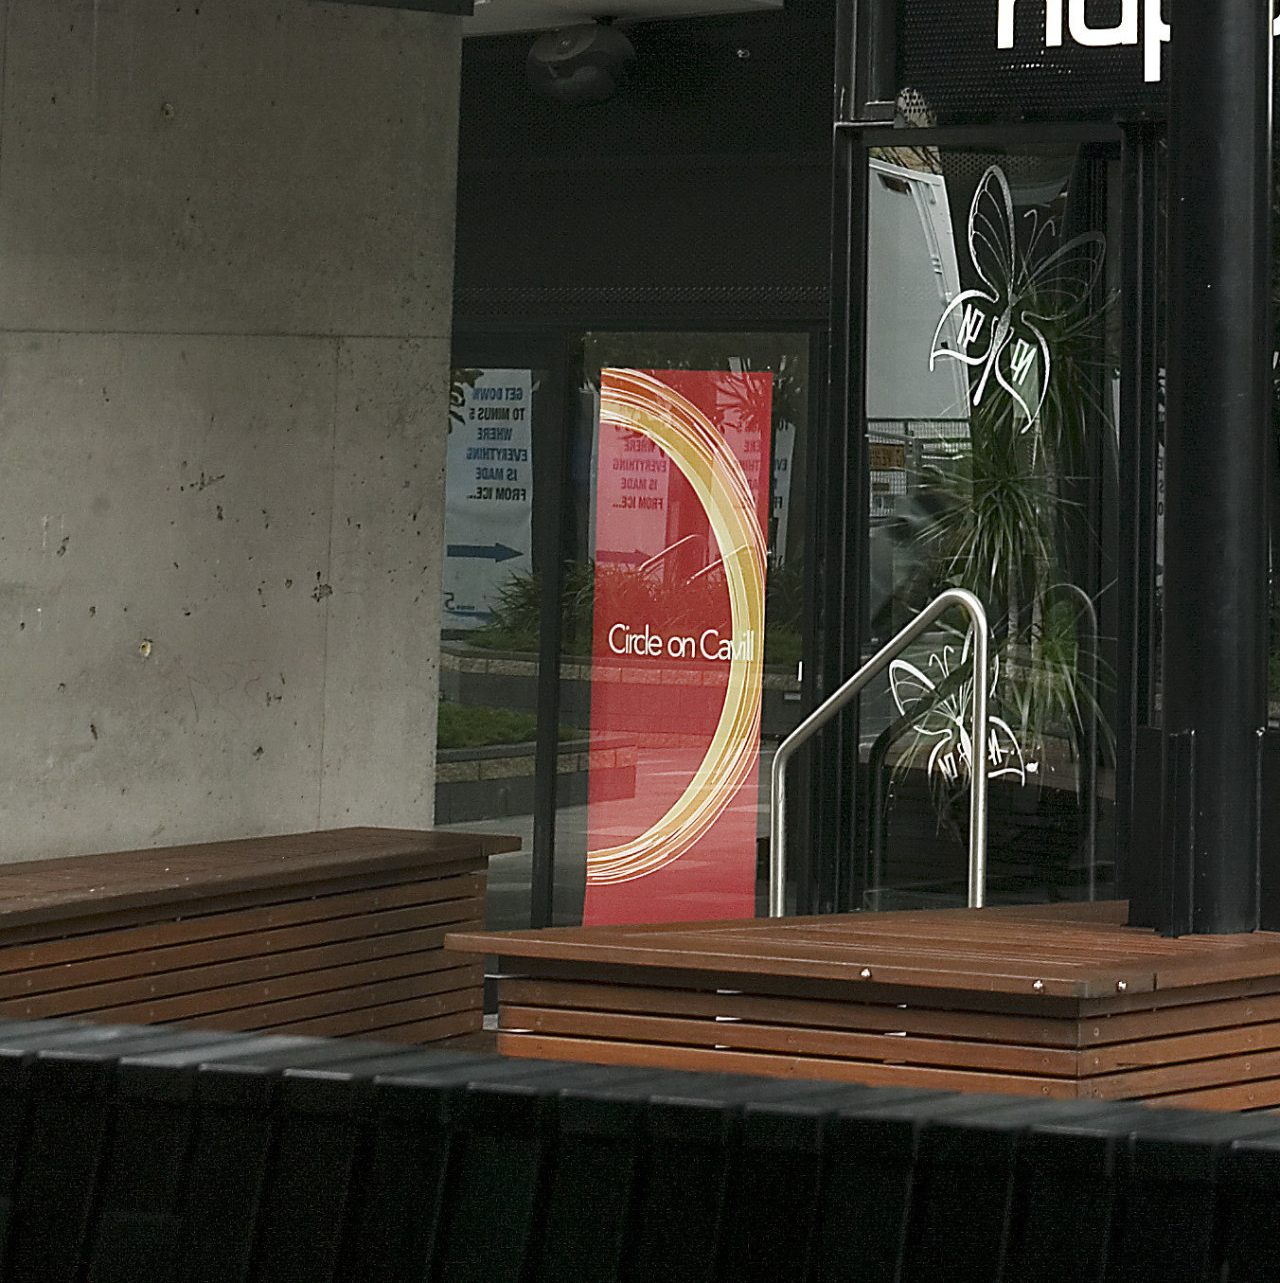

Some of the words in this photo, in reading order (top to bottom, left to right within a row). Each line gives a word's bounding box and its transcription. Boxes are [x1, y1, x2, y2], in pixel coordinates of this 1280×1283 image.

[608, 623, 663, 656] Circle
[667, 635, 696, 658] on
[700, 629, 754, 661] Cavill
